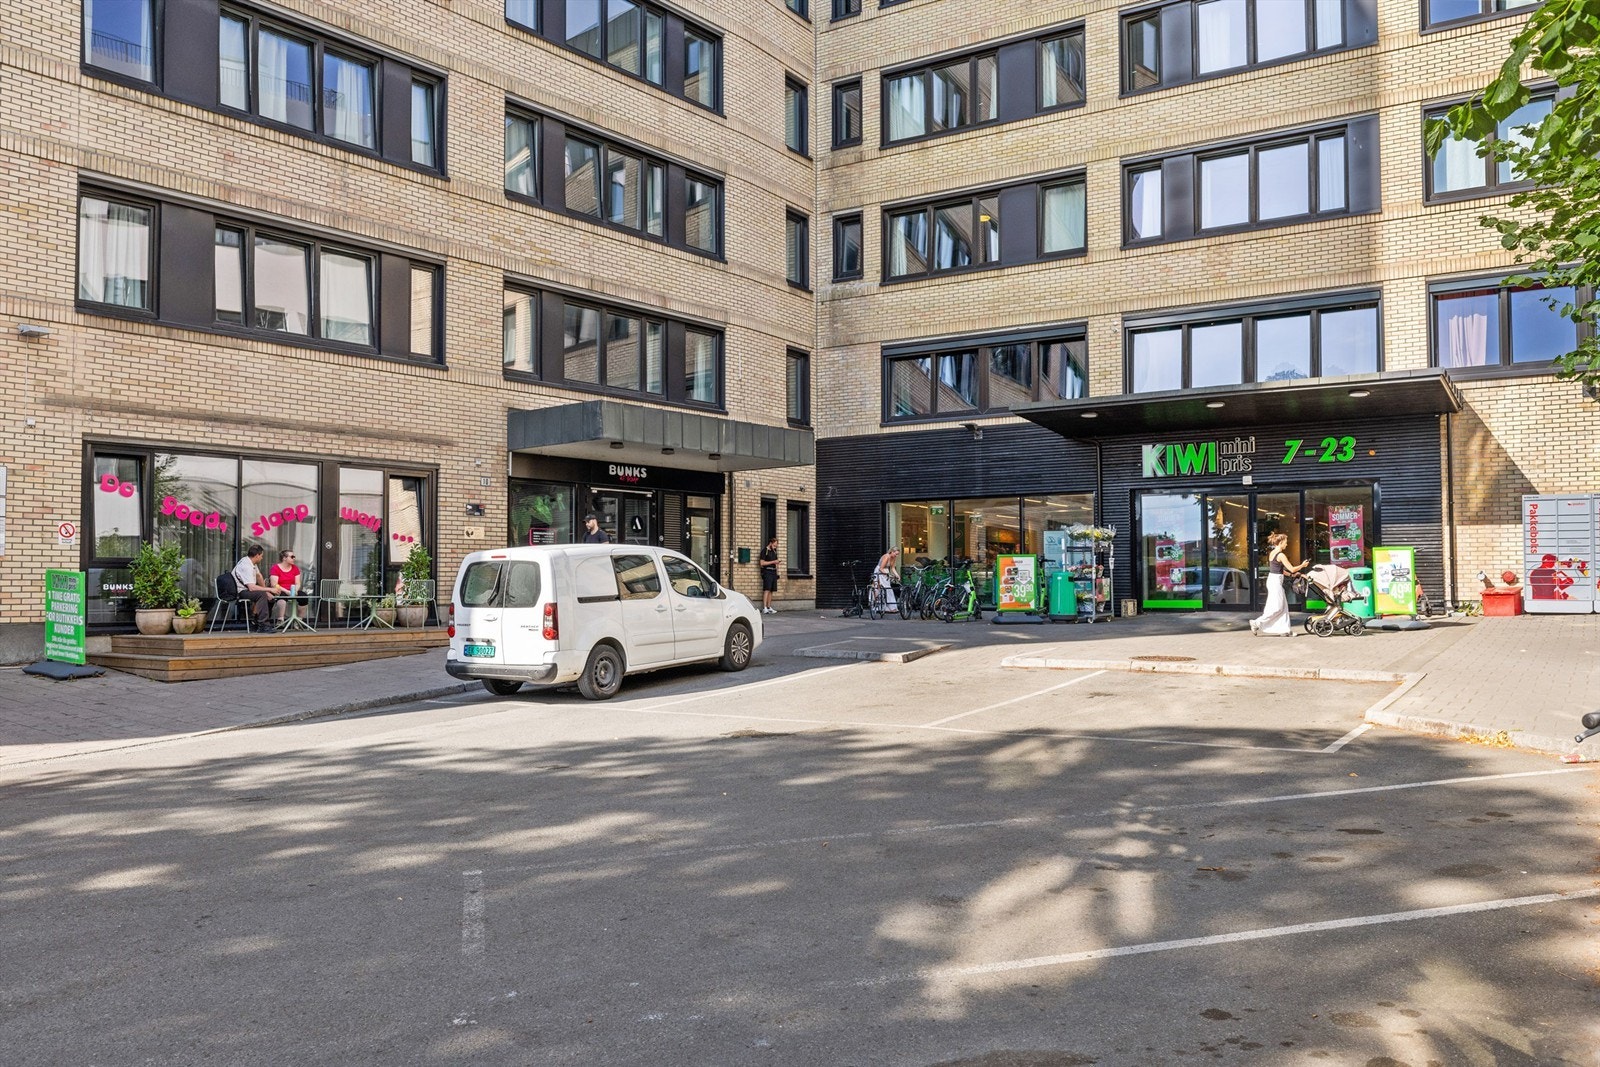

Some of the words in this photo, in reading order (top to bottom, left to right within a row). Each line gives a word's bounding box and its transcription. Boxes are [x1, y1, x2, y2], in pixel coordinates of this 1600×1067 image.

[1219, 436, 1255, 455] mini
[1141, 441, 1218, 478] KIWI
[1219, 455, 1252, 475] pris
[608, 464, 647, 478] BUNKS
[100, 473, 134, 498] Do
[160, 495, 227, 533] good,
[251, 504, 309, 537] sleep
[341, 506, 382, 533] well
[1529, 503, 1539, 554] Pakkeboks
[103, 583, 134, 591] BUNKS
[47, 590, 51, 599] 1
[63, 592, 81, 603] GRATIS
[51, 601, 78, 613] PARKERING
[54, 623, 75, 635] KUNDER
